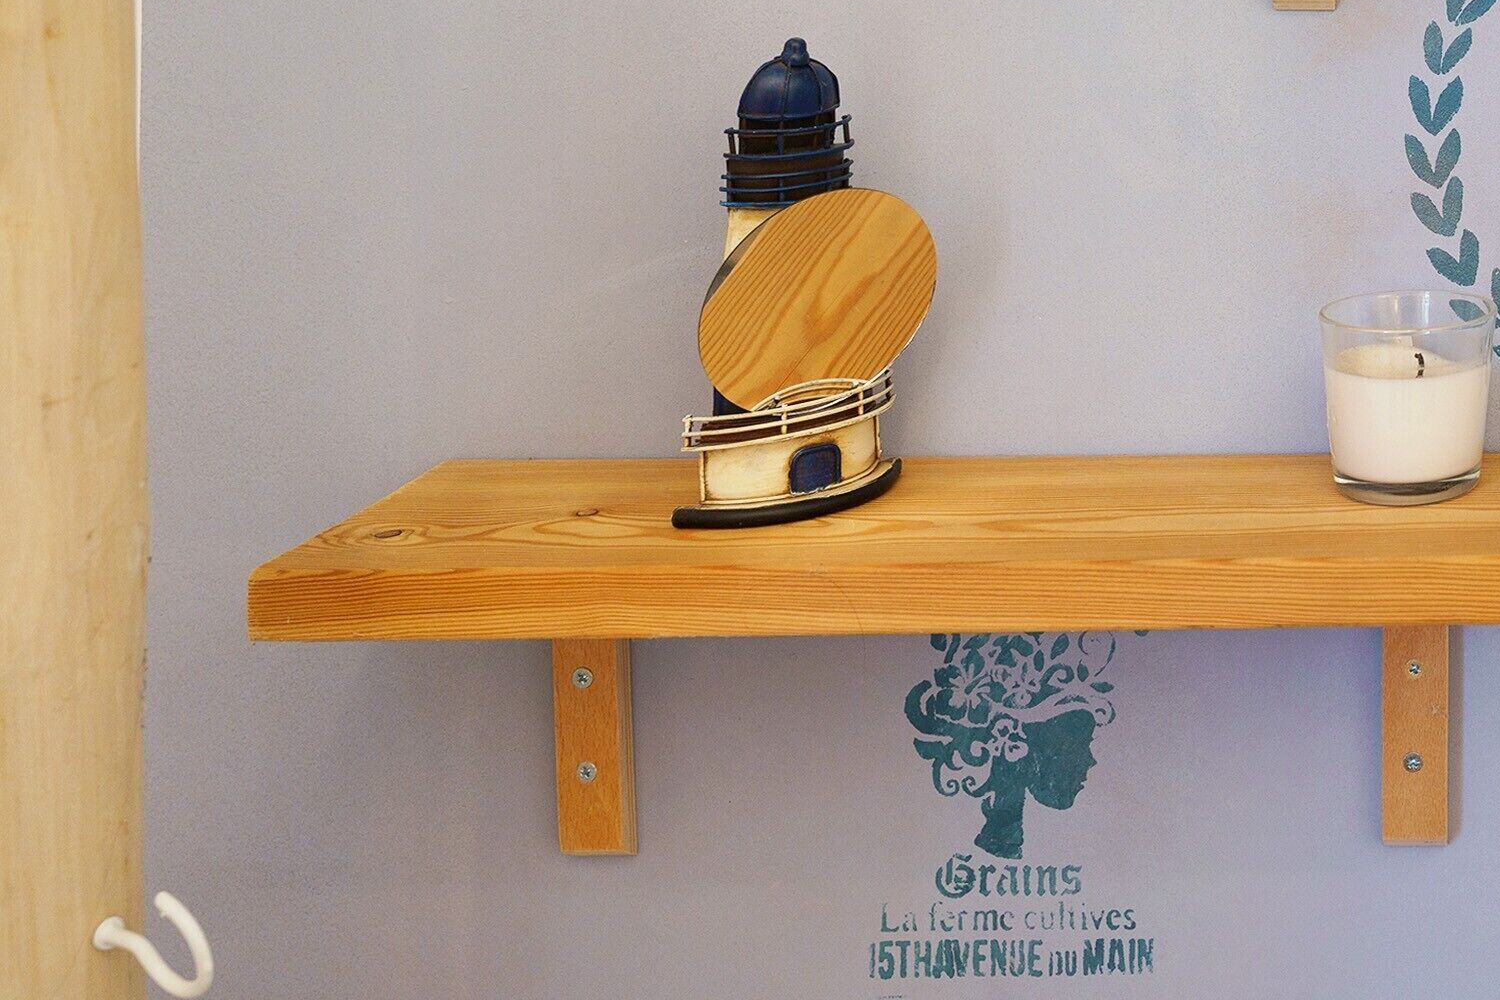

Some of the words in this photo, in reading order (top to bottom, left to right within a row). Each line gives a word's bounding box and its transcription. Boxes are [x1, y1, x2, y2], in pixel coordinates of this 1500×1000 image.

[935, 853, 1083, 899] Grains
[880, 902, 918, 933] La
[928, 901, 1015, 932] ferme
[1024, 901, 1137, 932] cultives
[1083, 937, 1155, 977] MAIN
